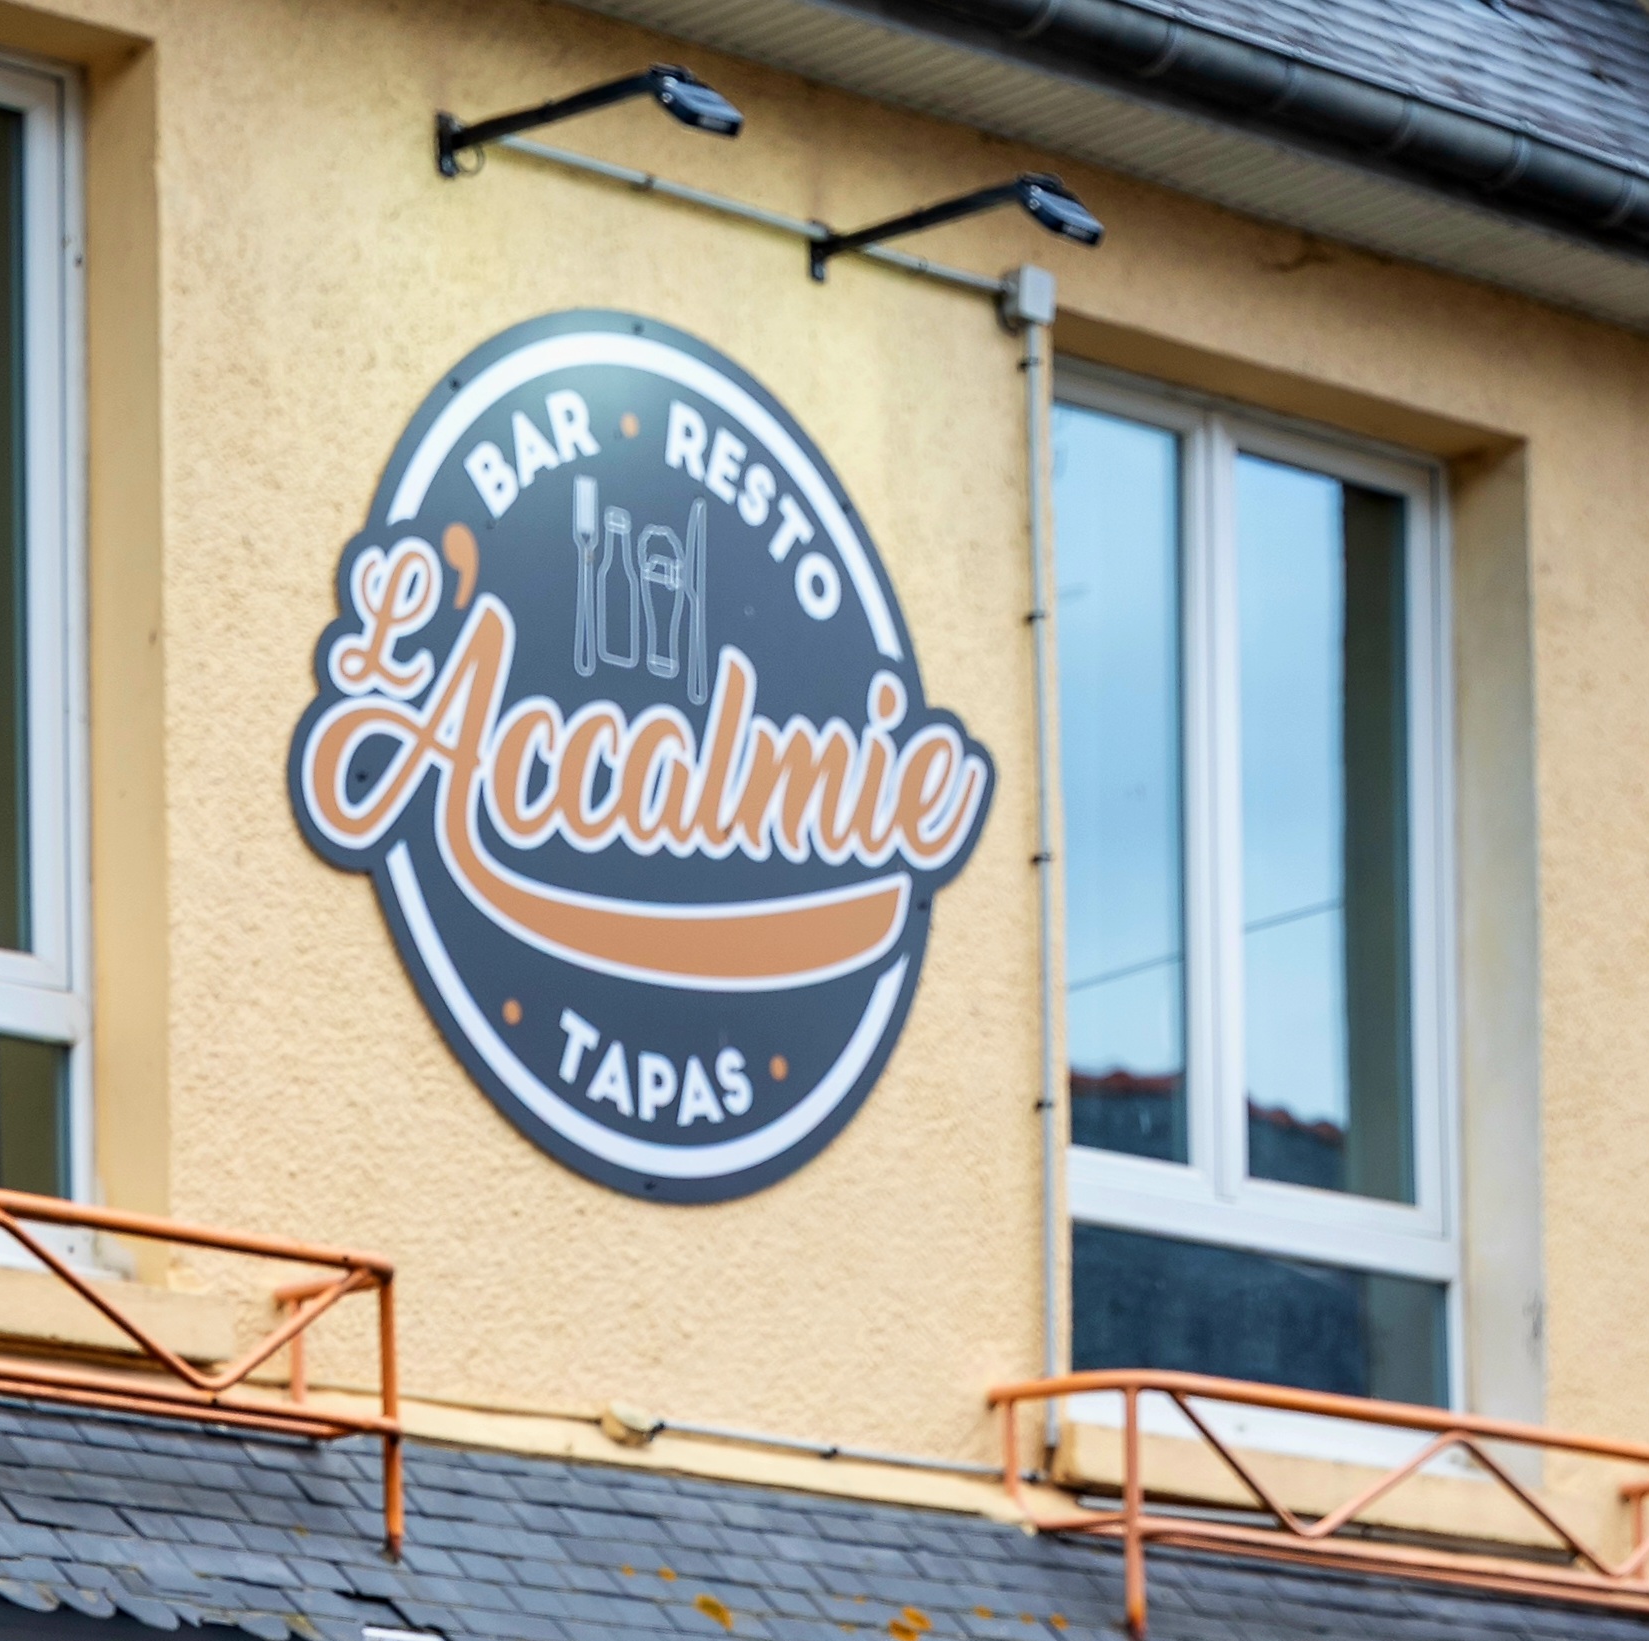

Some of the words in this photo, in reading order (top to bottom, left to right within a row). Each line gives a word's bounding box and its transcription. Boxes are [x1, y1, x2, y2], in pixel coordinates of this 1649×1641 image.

[463, 388, 601, 518] BAR
[663, 399, 842, 621] RESTO
[303, 522, 988, 991] L'Accalmie
[557, 1008, 753, 1128] TAPAS
